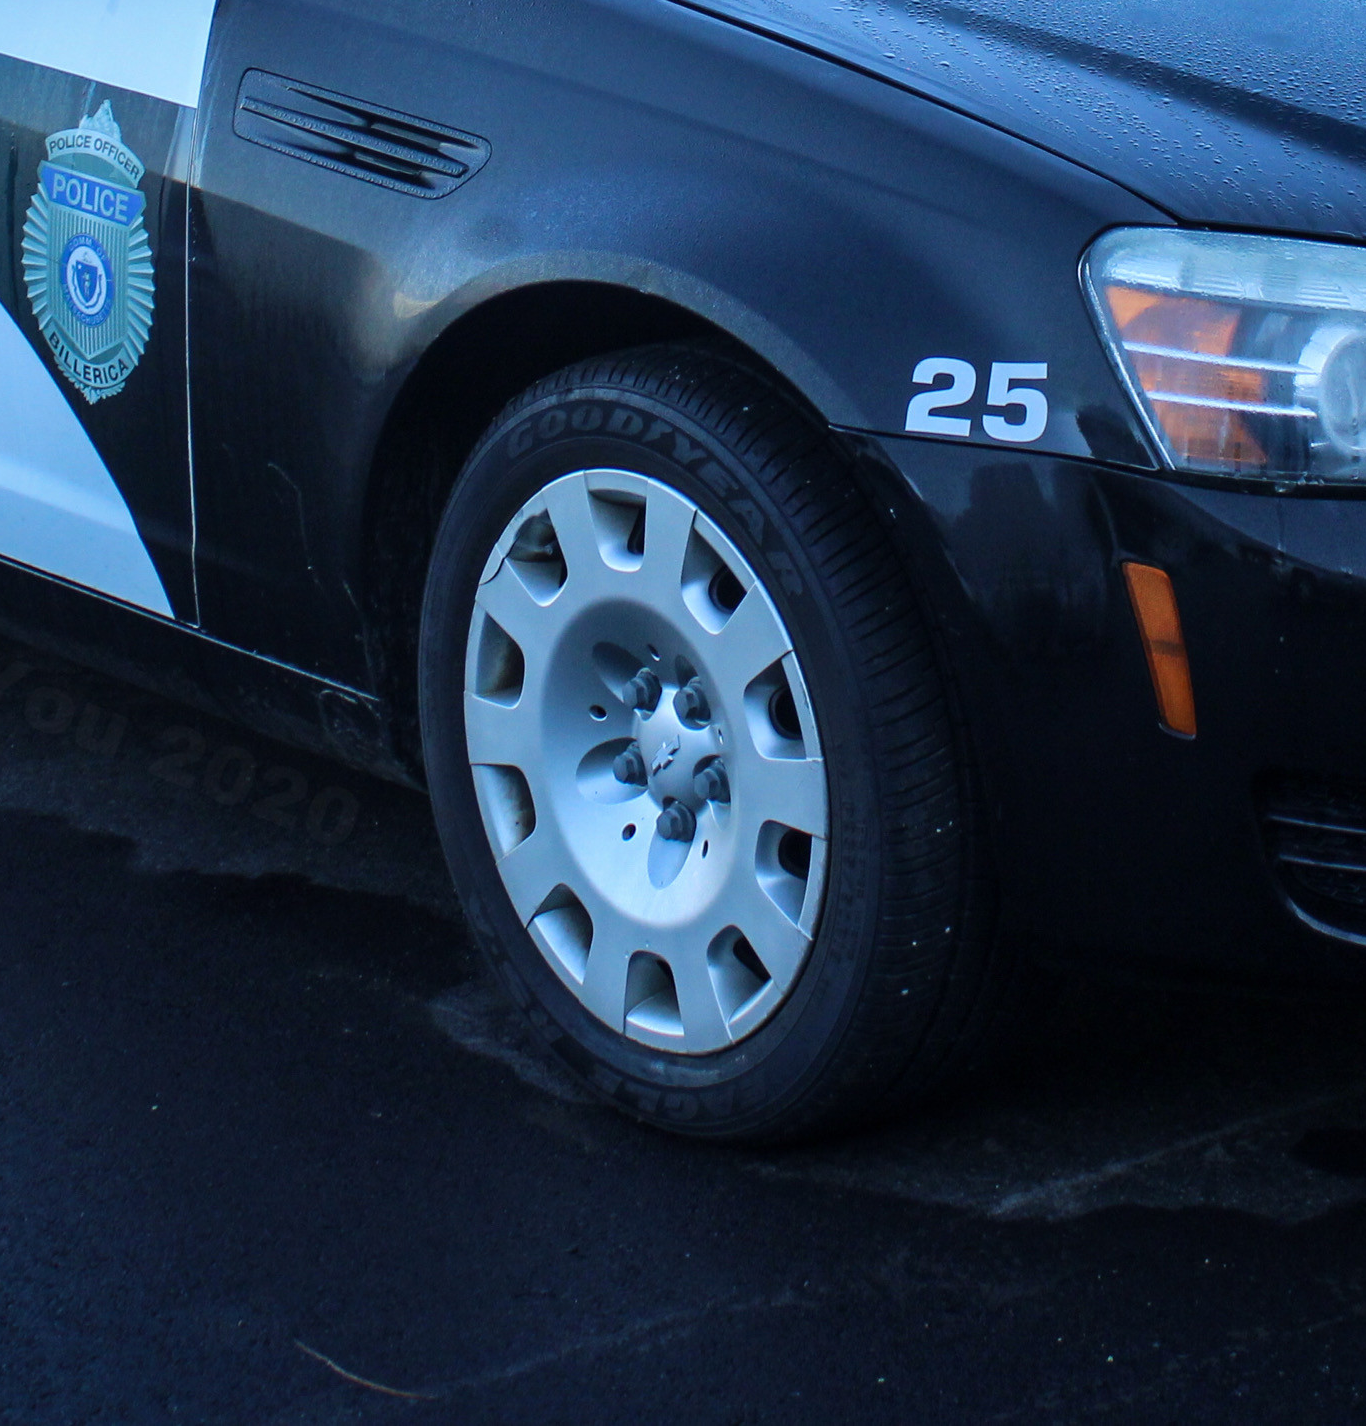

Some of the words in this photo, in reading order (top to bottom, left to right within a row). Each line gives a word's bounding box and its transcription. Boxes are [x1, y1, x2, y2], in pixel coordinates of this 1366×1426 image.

[49, 135, 92, 154] POLICE
[94, 138, 140, 180] OFFICER
[52, 173, 129, 222] POLICE
[49, 331, 129, 385] BILLERICA
[905, 357, 1048, 443] 25
[506, 406, 804, 597] GOODYEAR
